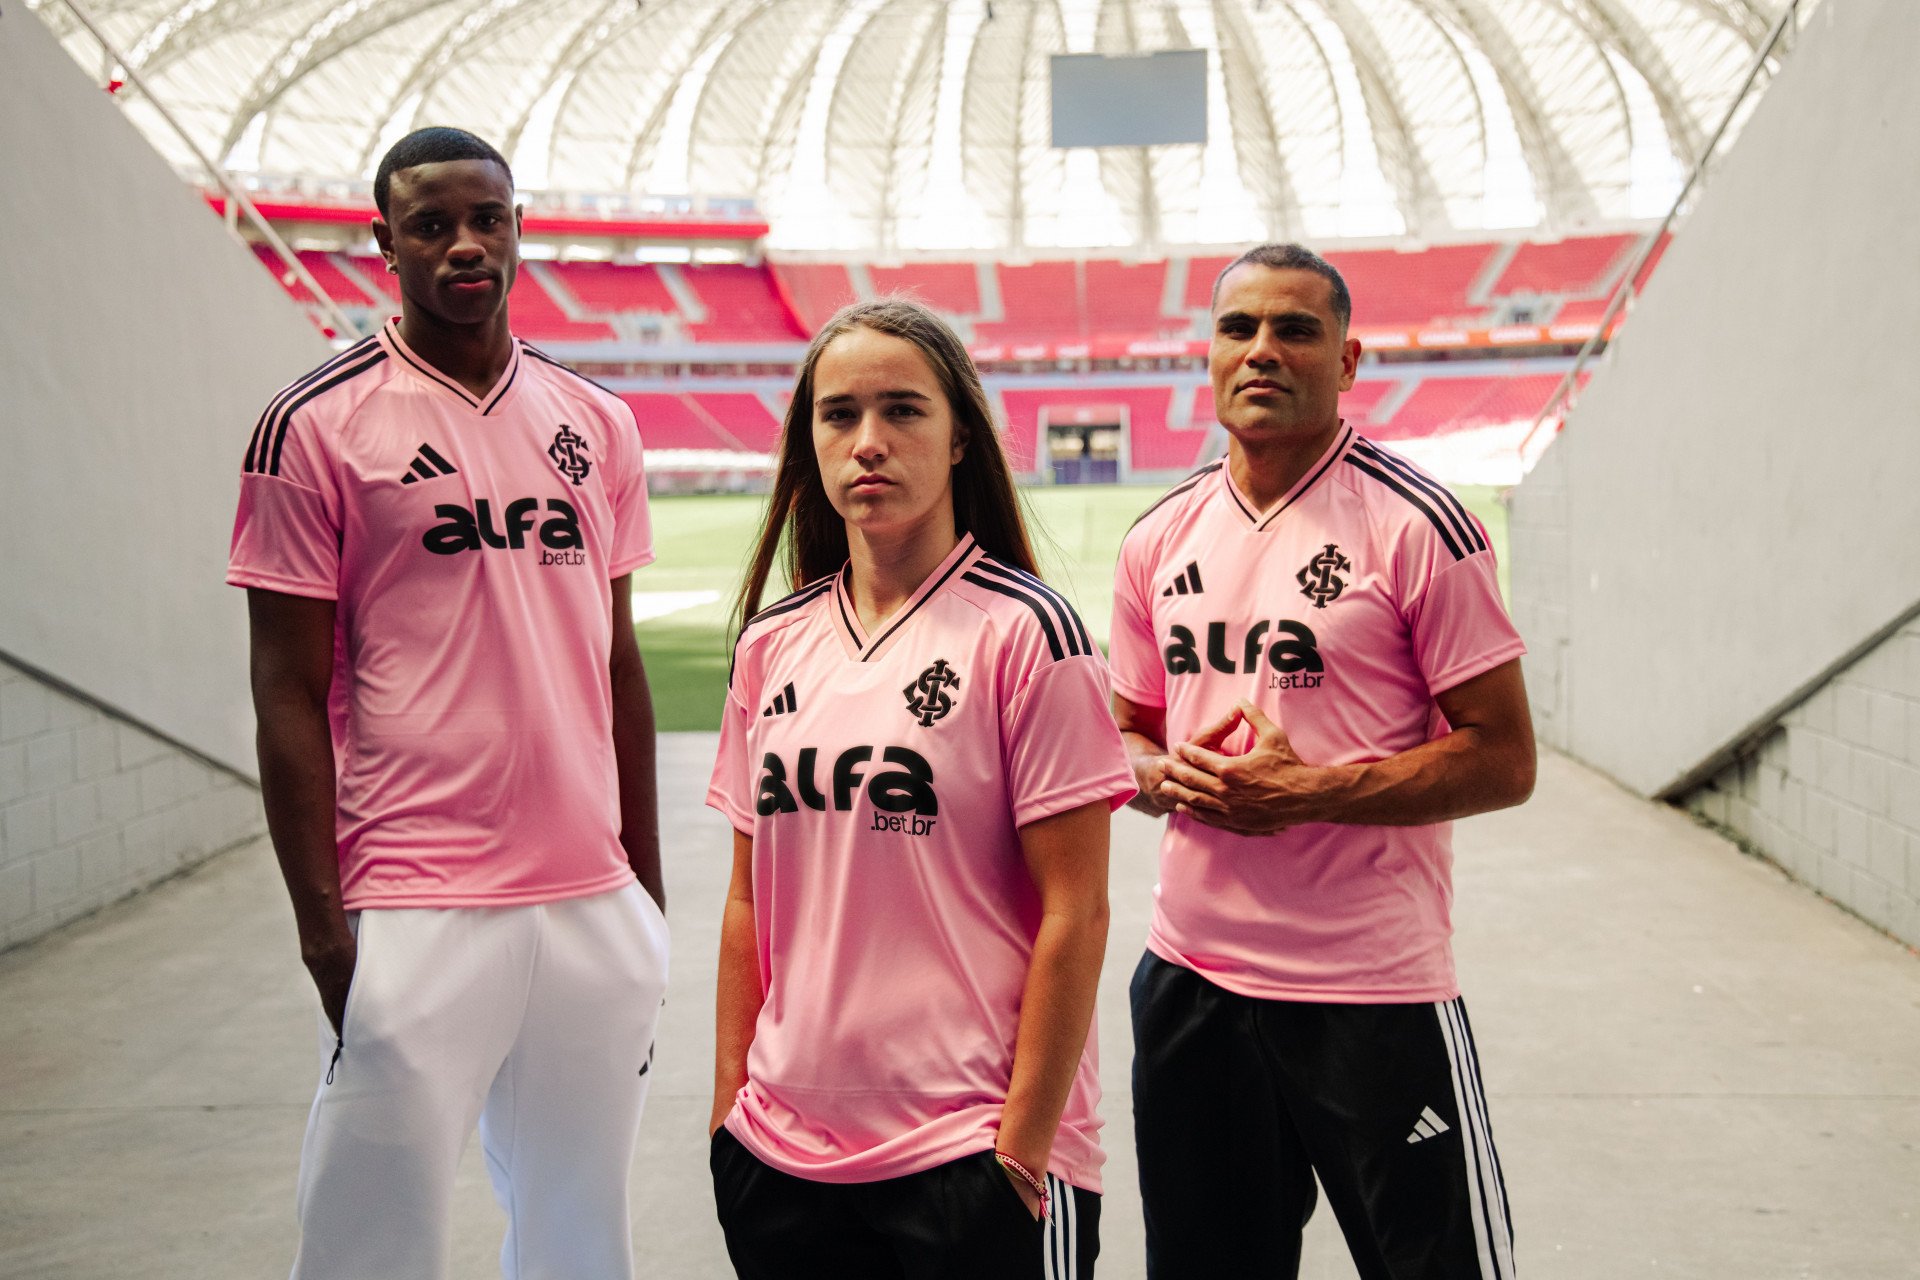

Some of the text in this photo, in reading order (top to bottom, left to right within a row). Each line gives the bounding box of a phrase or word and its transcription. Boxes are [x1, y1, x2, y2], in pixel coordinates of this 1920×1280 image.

[422, 498, 585, 556] alfa
[1164, 619, 1325, 676] alfa
[756, 745, 939, 817] alfa
[870, 811, 936, 836] .bet.br
